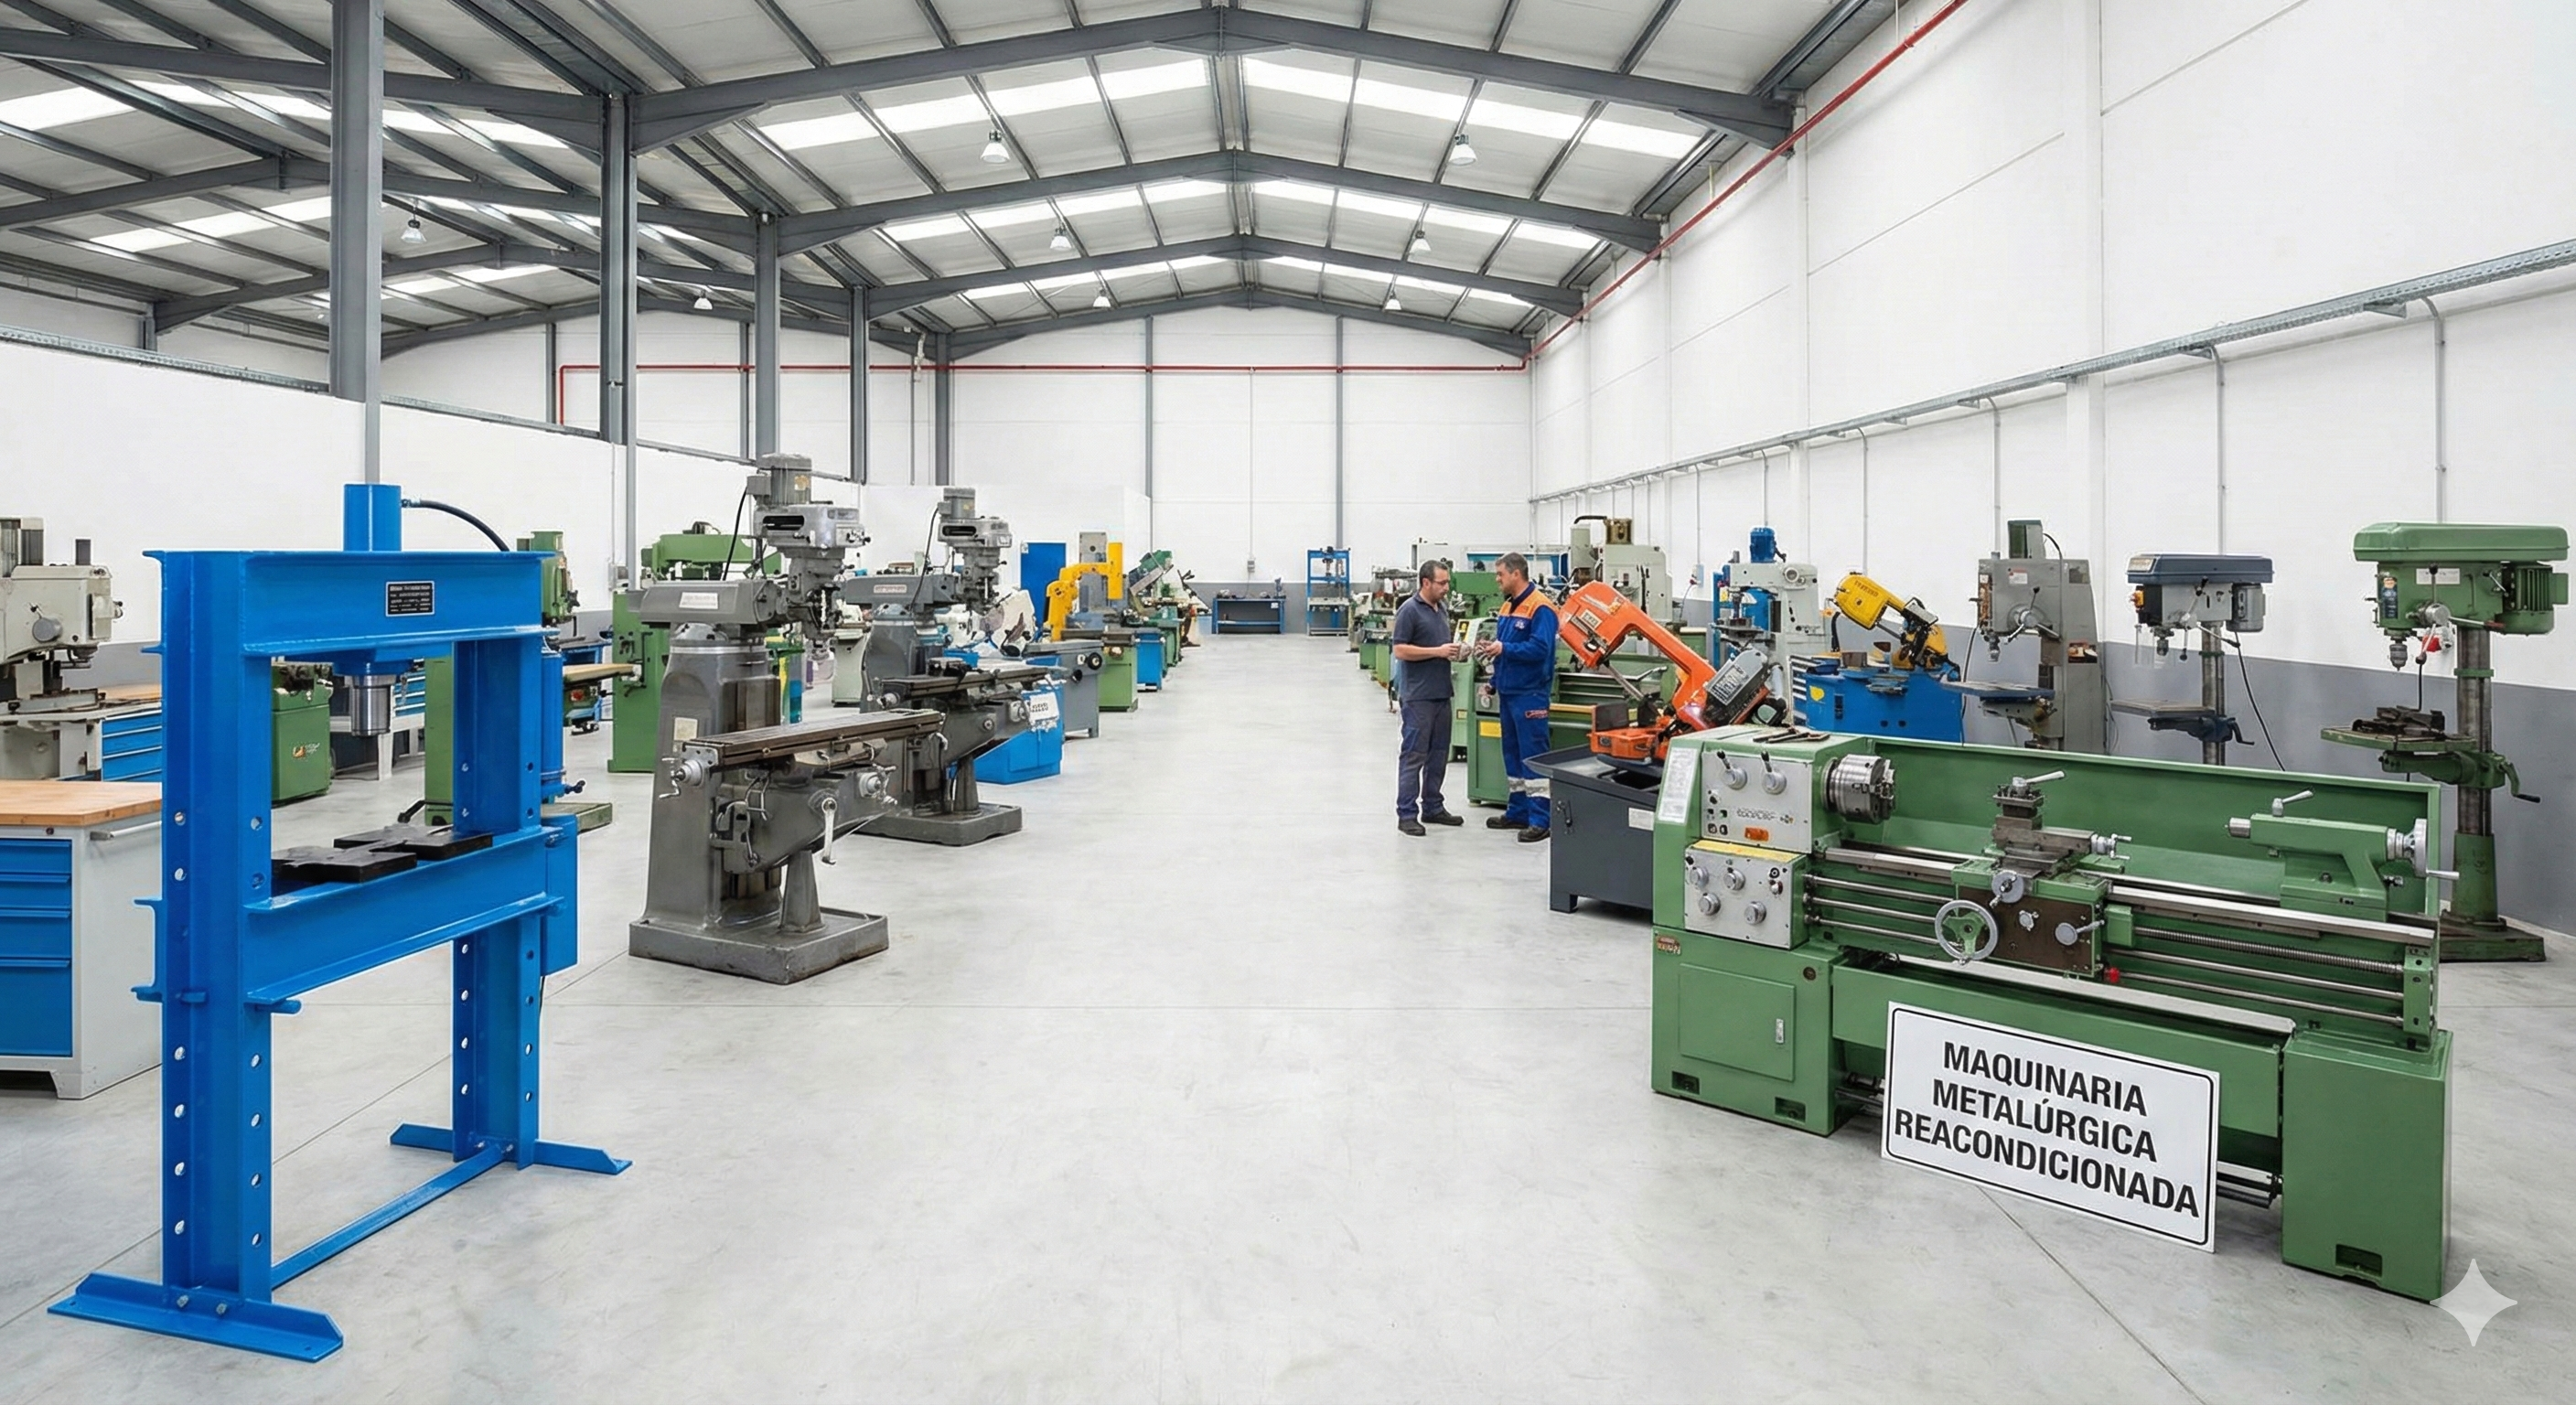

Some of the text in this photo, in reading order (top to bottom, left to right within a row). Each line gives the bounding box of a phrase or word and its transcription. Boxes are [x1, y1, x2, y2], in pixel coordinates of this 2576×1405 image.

[1933, 1078, 2157, 1163] METALÚRGICA
[1944, 1041, 2147, 1117] MAQUINARIA
[1894, 1108, 2199, 1218] REACONDICIONADA
